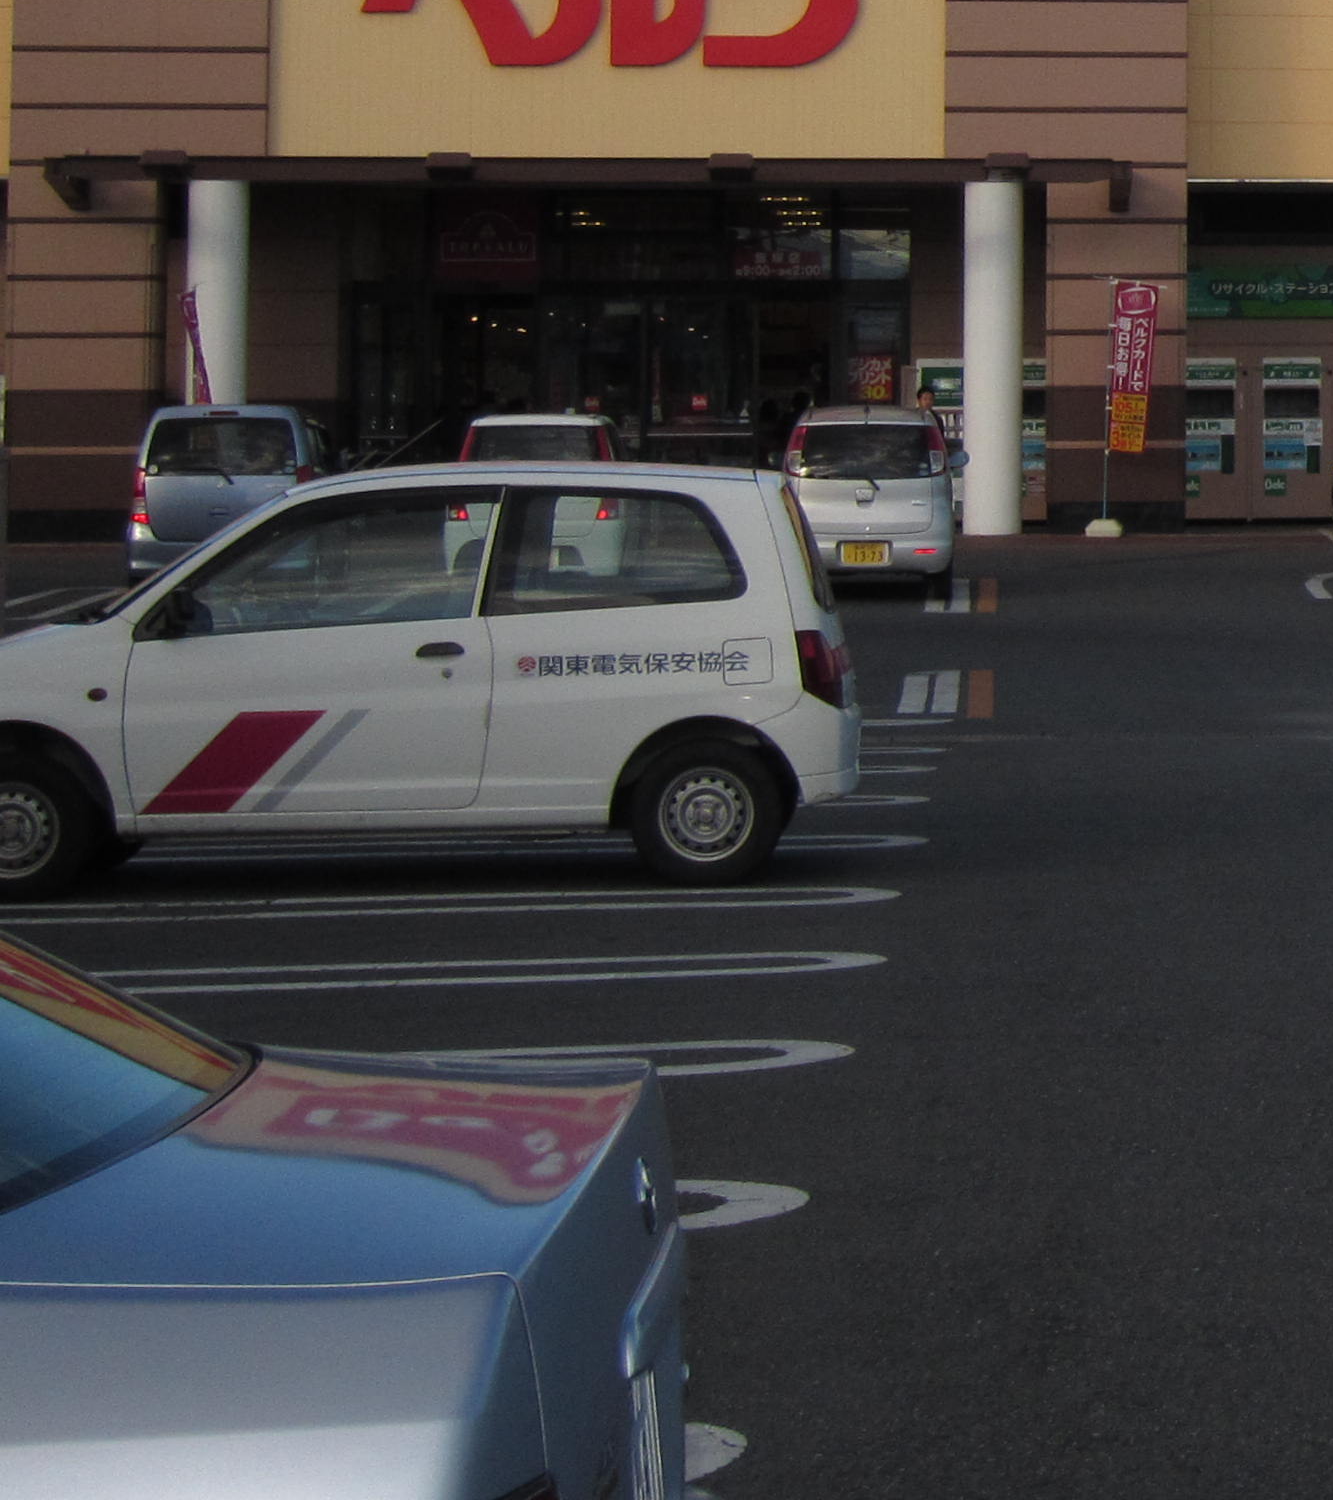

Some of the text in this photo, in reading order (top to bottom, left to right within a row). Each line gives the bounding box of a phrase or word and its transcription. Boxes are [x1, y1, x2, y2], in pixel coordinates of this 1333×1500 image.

[538, 651, 750, 677] 関東電気保安協会
